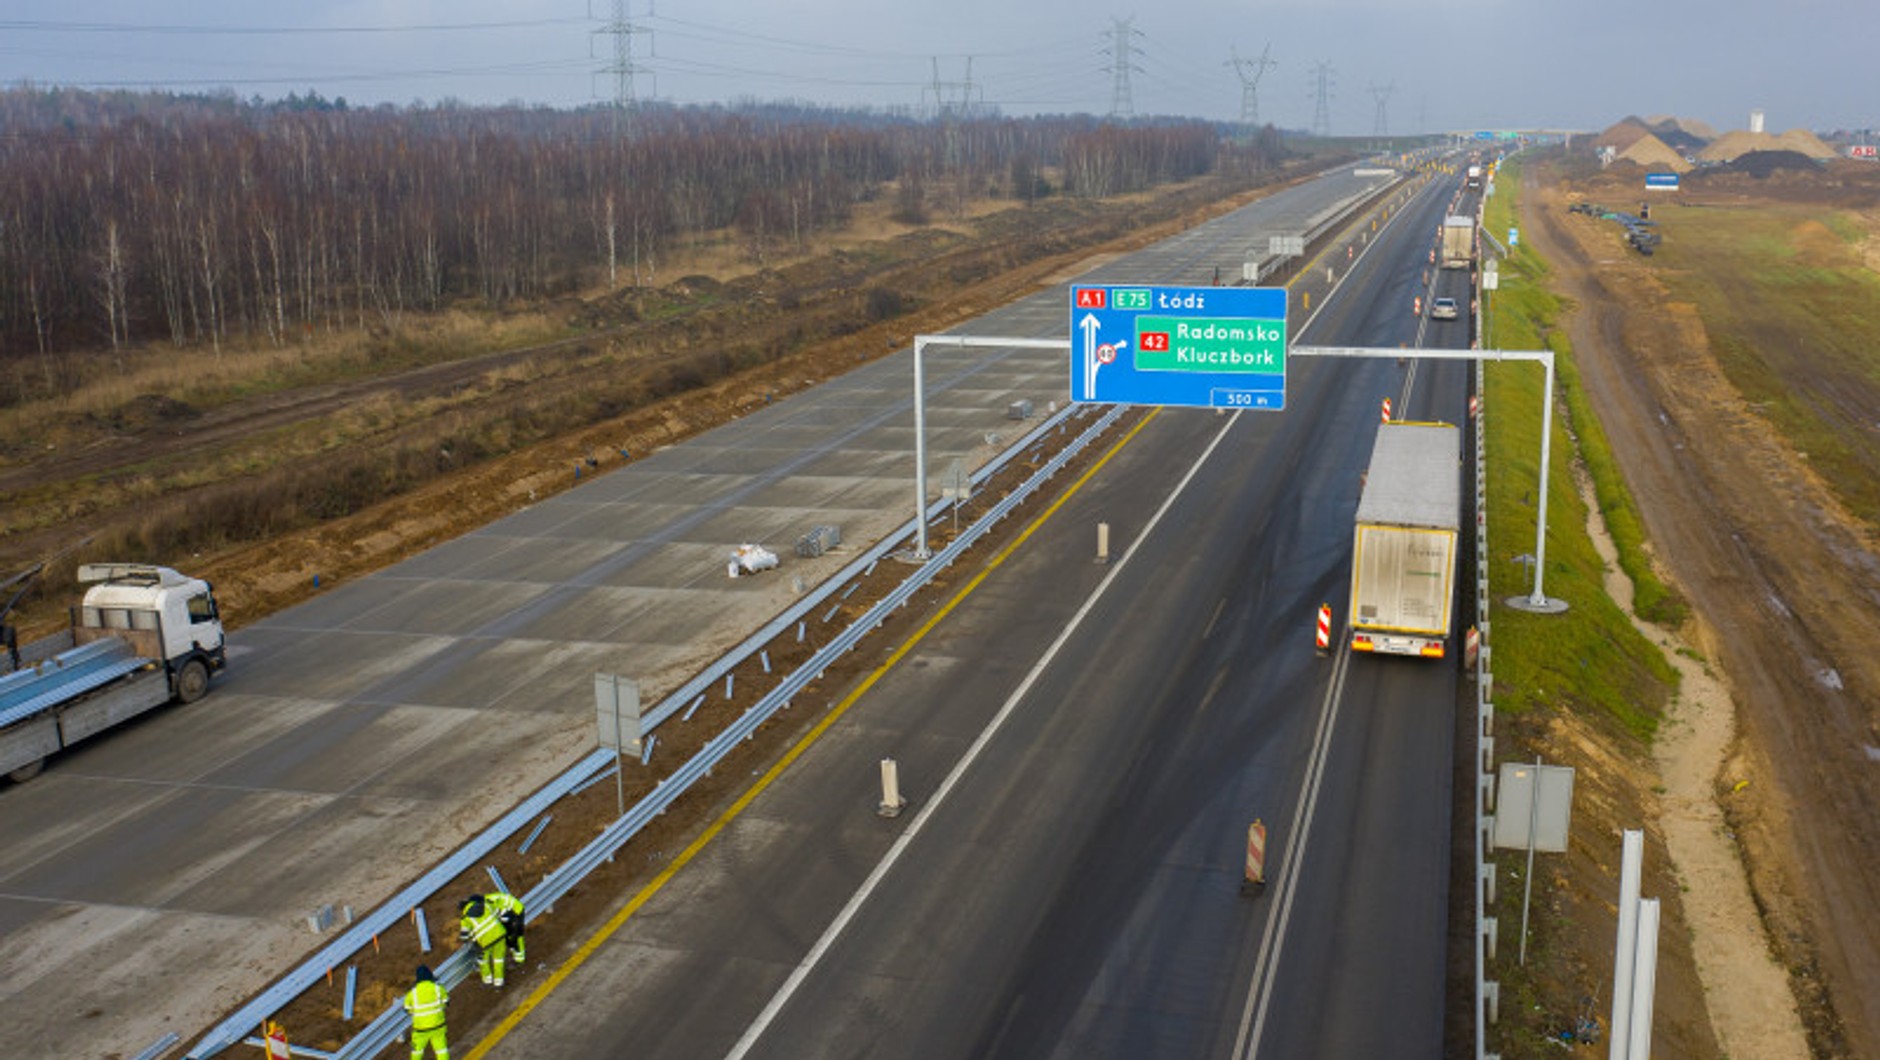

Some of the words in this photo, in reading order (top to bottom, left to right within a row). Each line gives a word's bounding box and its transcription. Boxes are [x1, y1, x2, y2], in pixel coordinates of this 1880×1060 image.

[1176, 322, 1280, 342] Radomsko
[1144, 334, 1166, 349] 42
[1176, 346, 1275, 366] Kluczbork
[1226, 393, 1252, 406] 500
[1256, 396, 1269, 406] m
